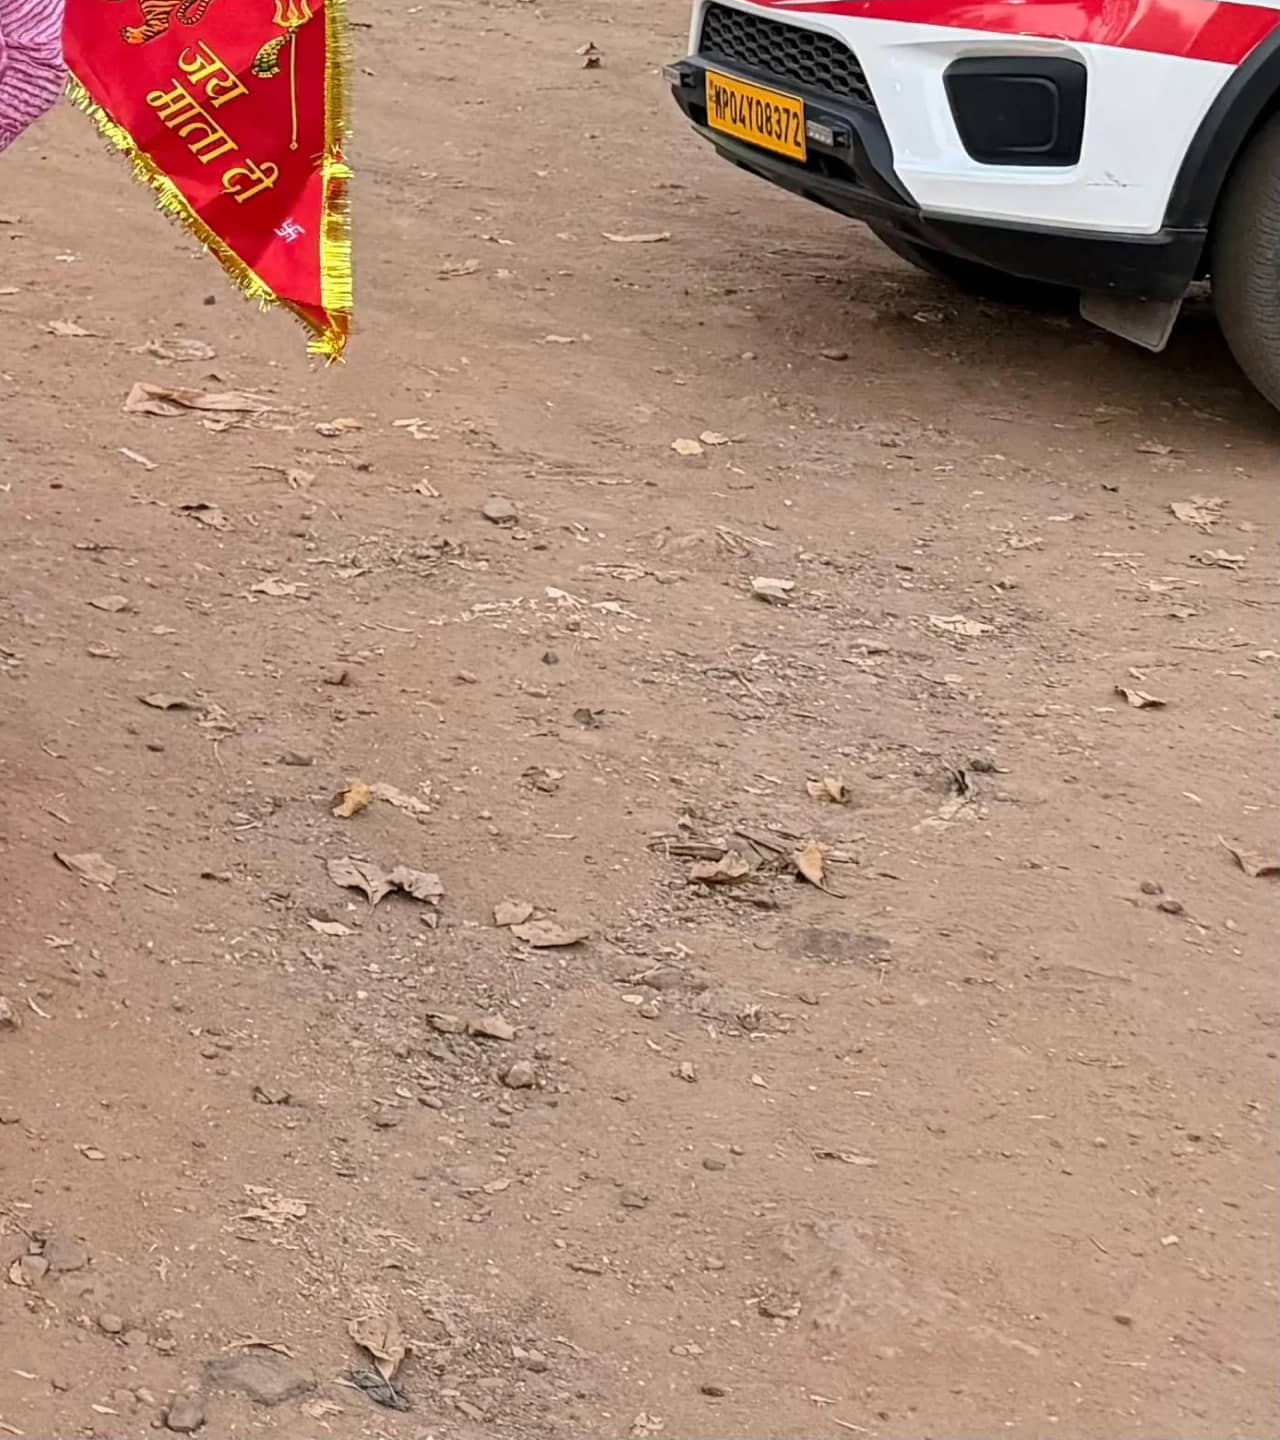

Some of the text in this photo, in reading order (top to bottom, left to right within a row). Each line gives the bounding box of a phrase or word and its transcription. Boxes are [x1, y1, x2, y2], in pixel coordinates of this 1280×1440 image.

[178, 40, 249, 108] जय
[146, 78, 279, 203] माता दी
